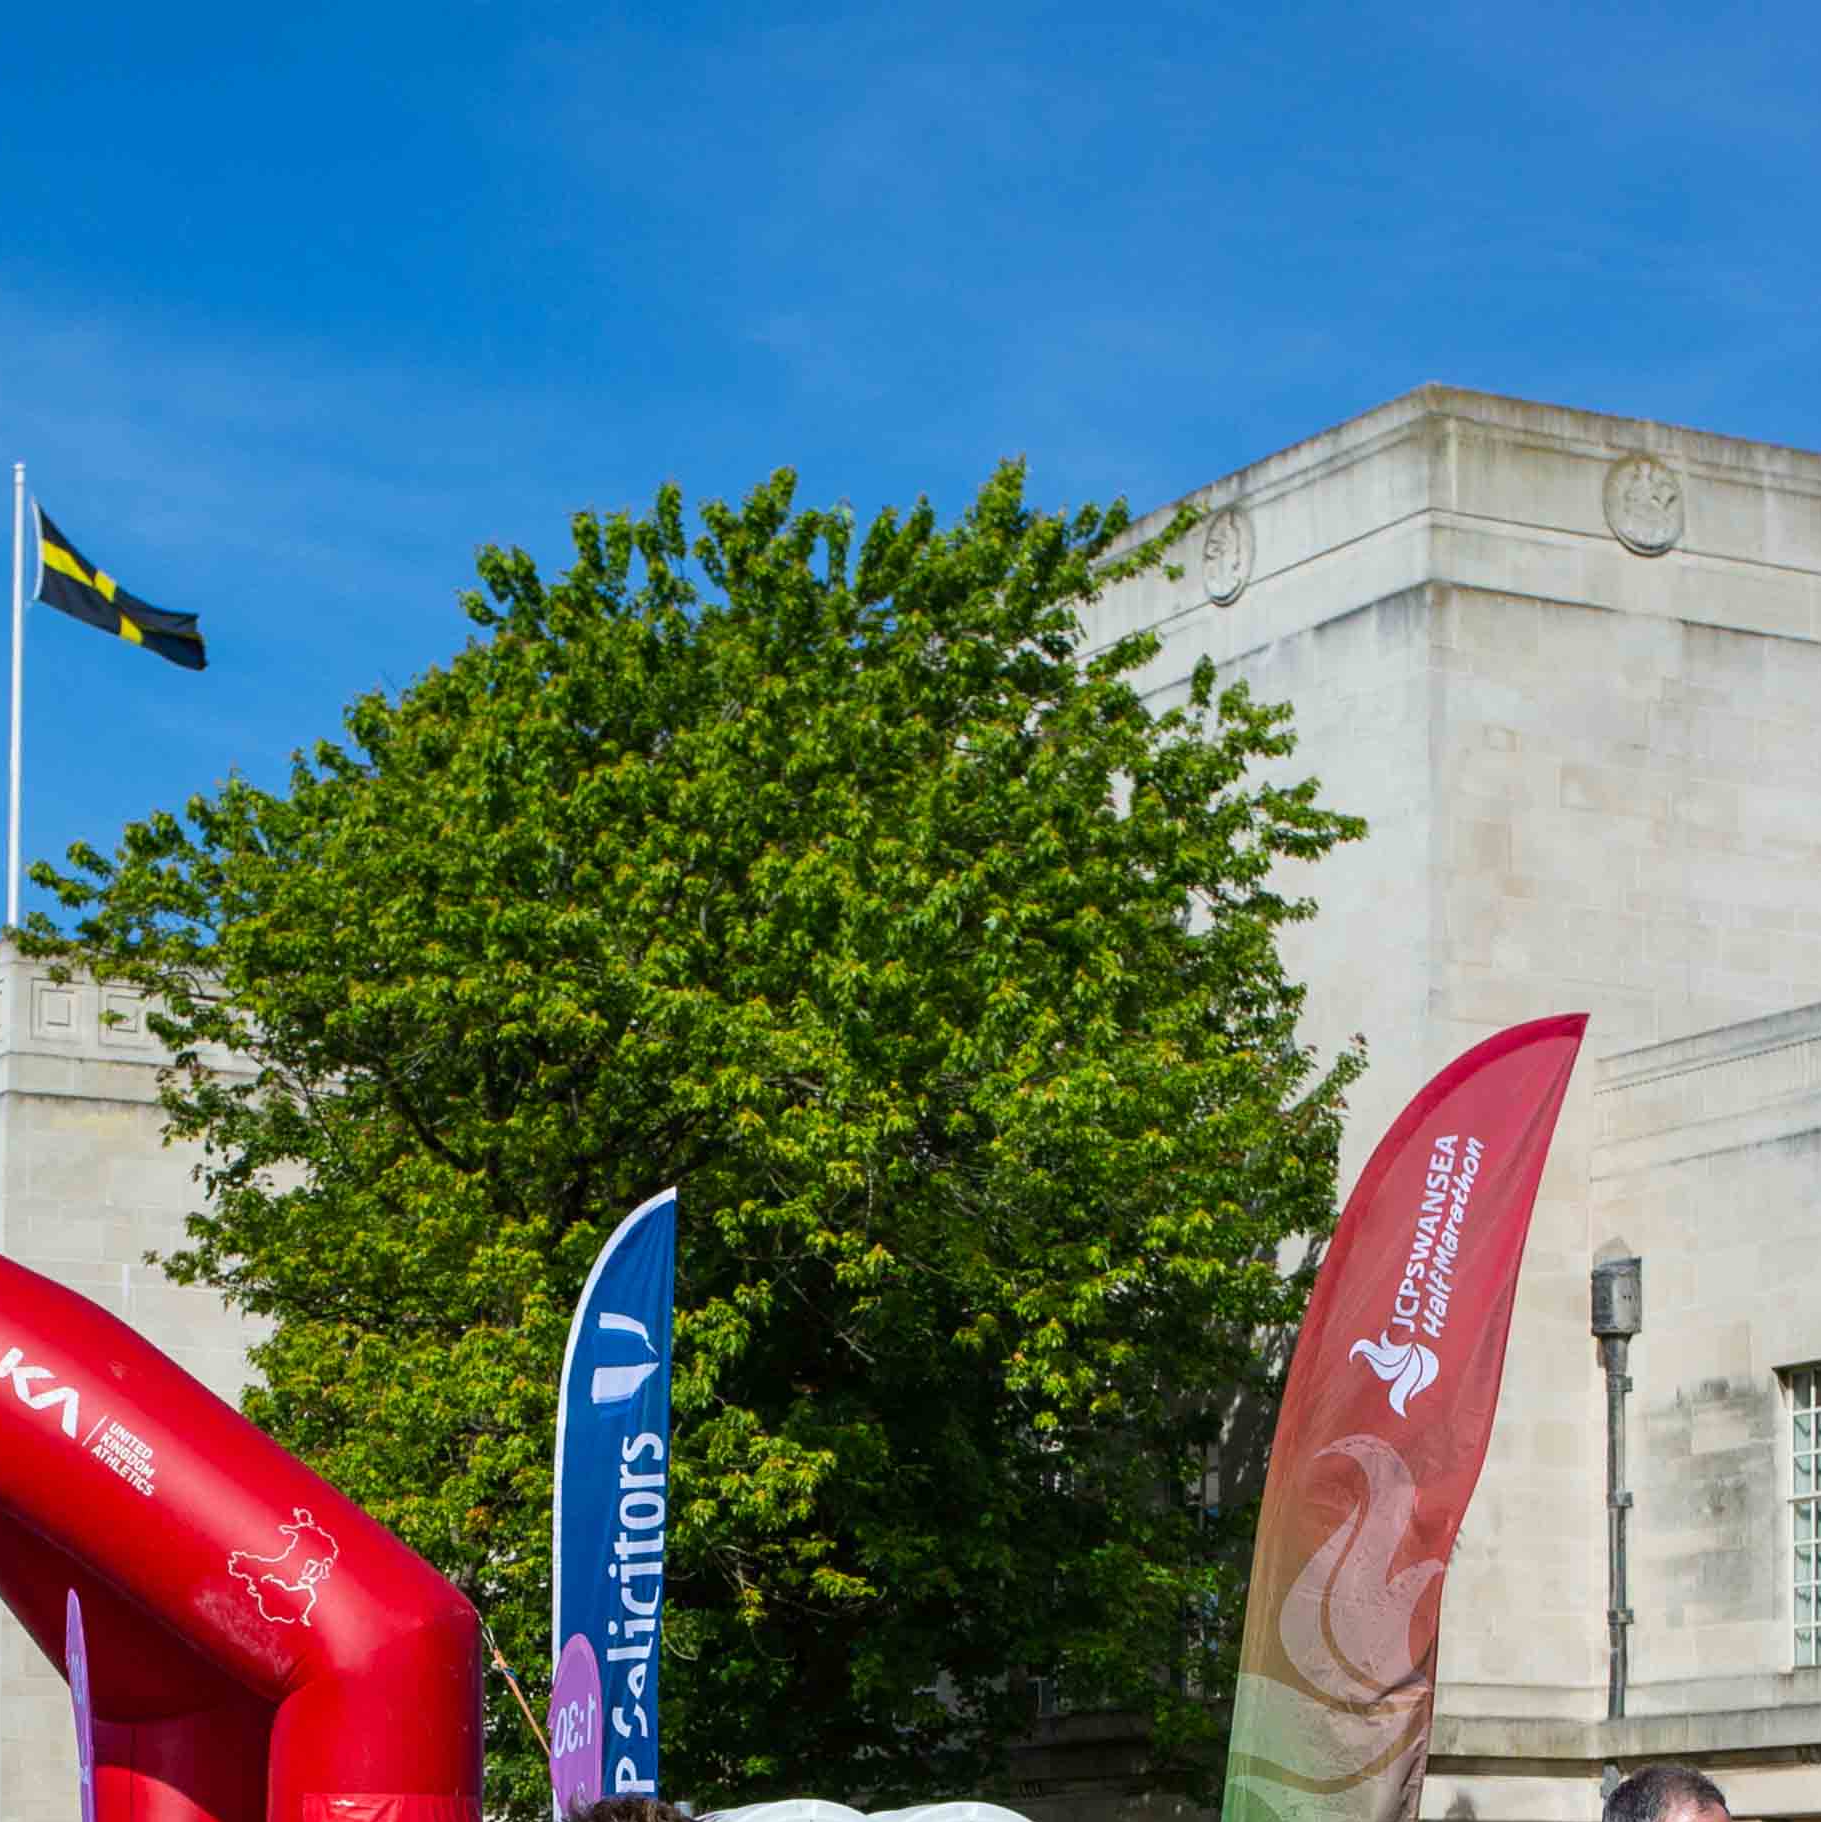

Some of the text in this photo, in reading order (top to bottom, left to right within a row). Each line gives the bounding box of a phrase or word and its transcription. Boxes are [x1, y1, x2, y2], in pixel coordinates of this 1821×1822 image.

[1391, 1134, 1460, 1334] JCPSWANSEA
[100, 1432, 156, 1479] KINGDOM
[108, 1421, 154, 1460] UNITED
[90, 1443, 156, 1498] ATHLETICS
